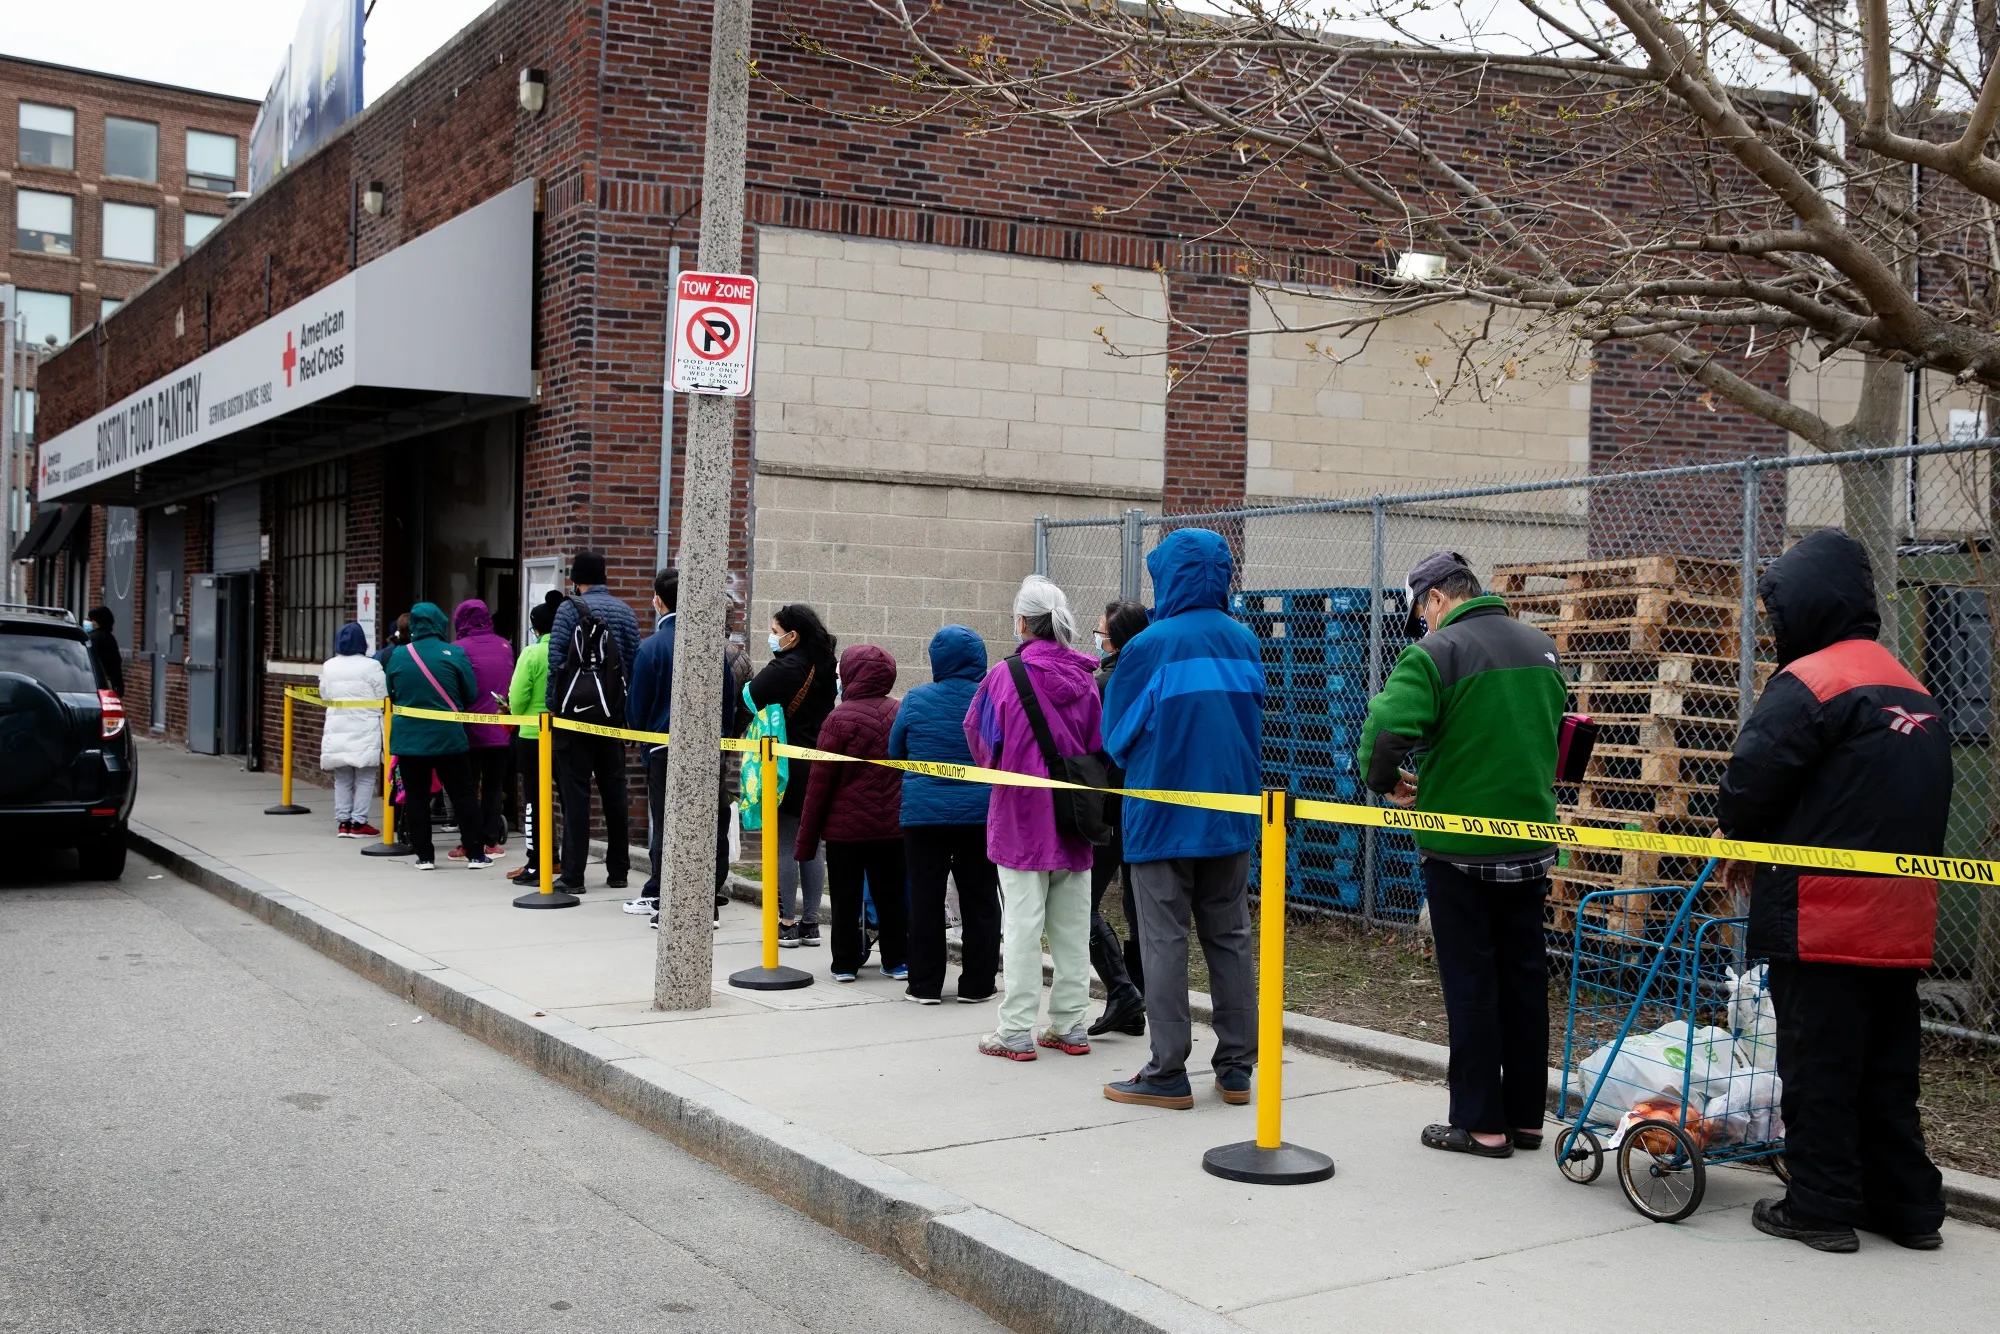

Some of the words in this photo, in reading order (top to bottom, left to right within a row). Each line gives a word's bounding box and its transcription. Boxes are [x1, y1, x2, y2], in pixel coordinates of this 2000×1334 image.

[682, 280, 711, 296] TOW
[715, 284, 752, 299] ZONE
[300, 310, 344, 350] American
[300, 350, 316, 382] Red
[318, 344, 344, 374] Cross
[683, 364, 715, 372] PICK-UP
[709, 361, 746, 369] PANTRY
[228, 393, 244, 419] BOSTON
[245, 386, 259, 411] SINCE
[97, 410, 127, 471] BOSTON
[130, 397, 154, 458] FOOD
[158, 372, 202, 446] PANTRY
[455, 713, 469, 721] CAUTION
[488, 715, 500, 723] ENTER
[575, 722, 592, 732] CAUTION
[609, 728, 622, 737] ENTER
[723, 739, 737, 750] ENTER
[936, 764, 966, 779] CAUTION
[1383, 810, 1446, 830] CAUTION
[1461, 818, 1485, 834] DO
[1488, 820, 1521, 837] NOT
[1528, 825, 1579, 842] ENTER
[1895, 856, 1994, 882] CAUTION
